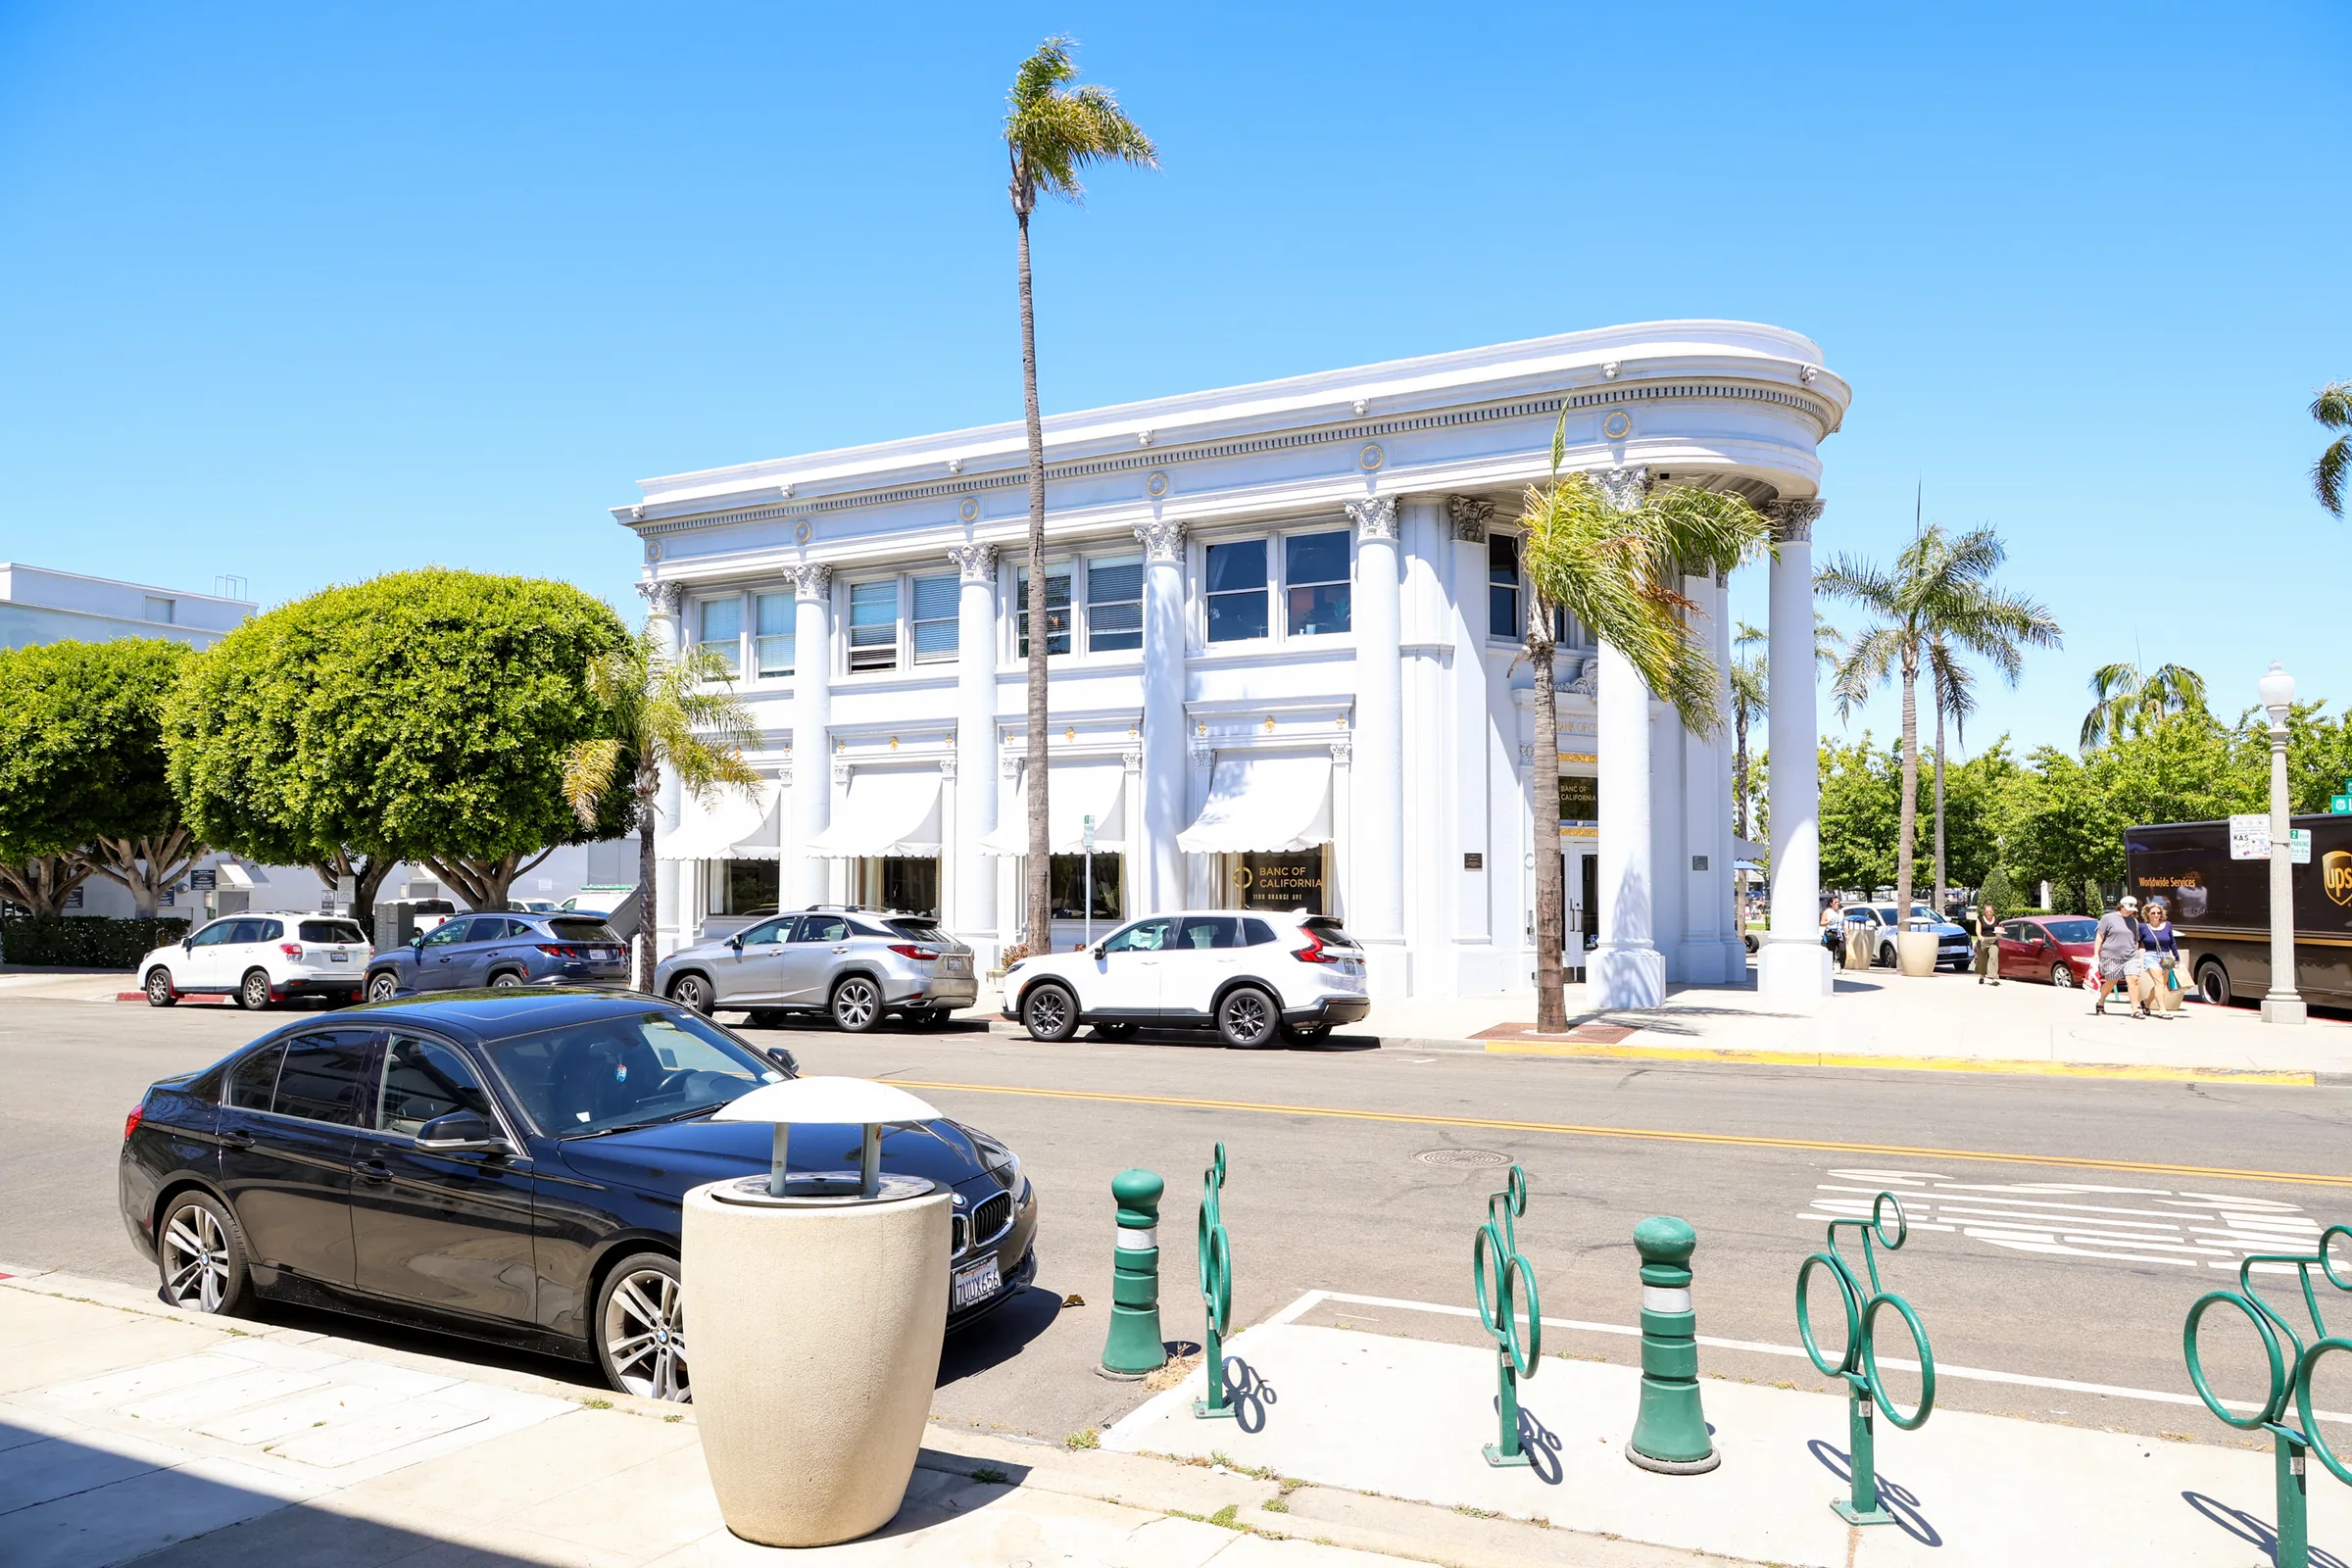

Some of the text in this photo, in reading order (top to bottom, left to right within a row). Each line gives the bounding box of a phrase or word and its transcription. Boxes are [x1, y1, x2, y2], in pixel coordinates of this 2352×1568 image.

[1259, 867, 1306, 876] BANC OF
[1259, 879, 1322, 888] CALIFORNIA
[2138, 876, 2196, 887] Worldwide Services
[2326, 867, 2352, 897] ups
[956, 1268, 1000, 1304] 7UUX656
